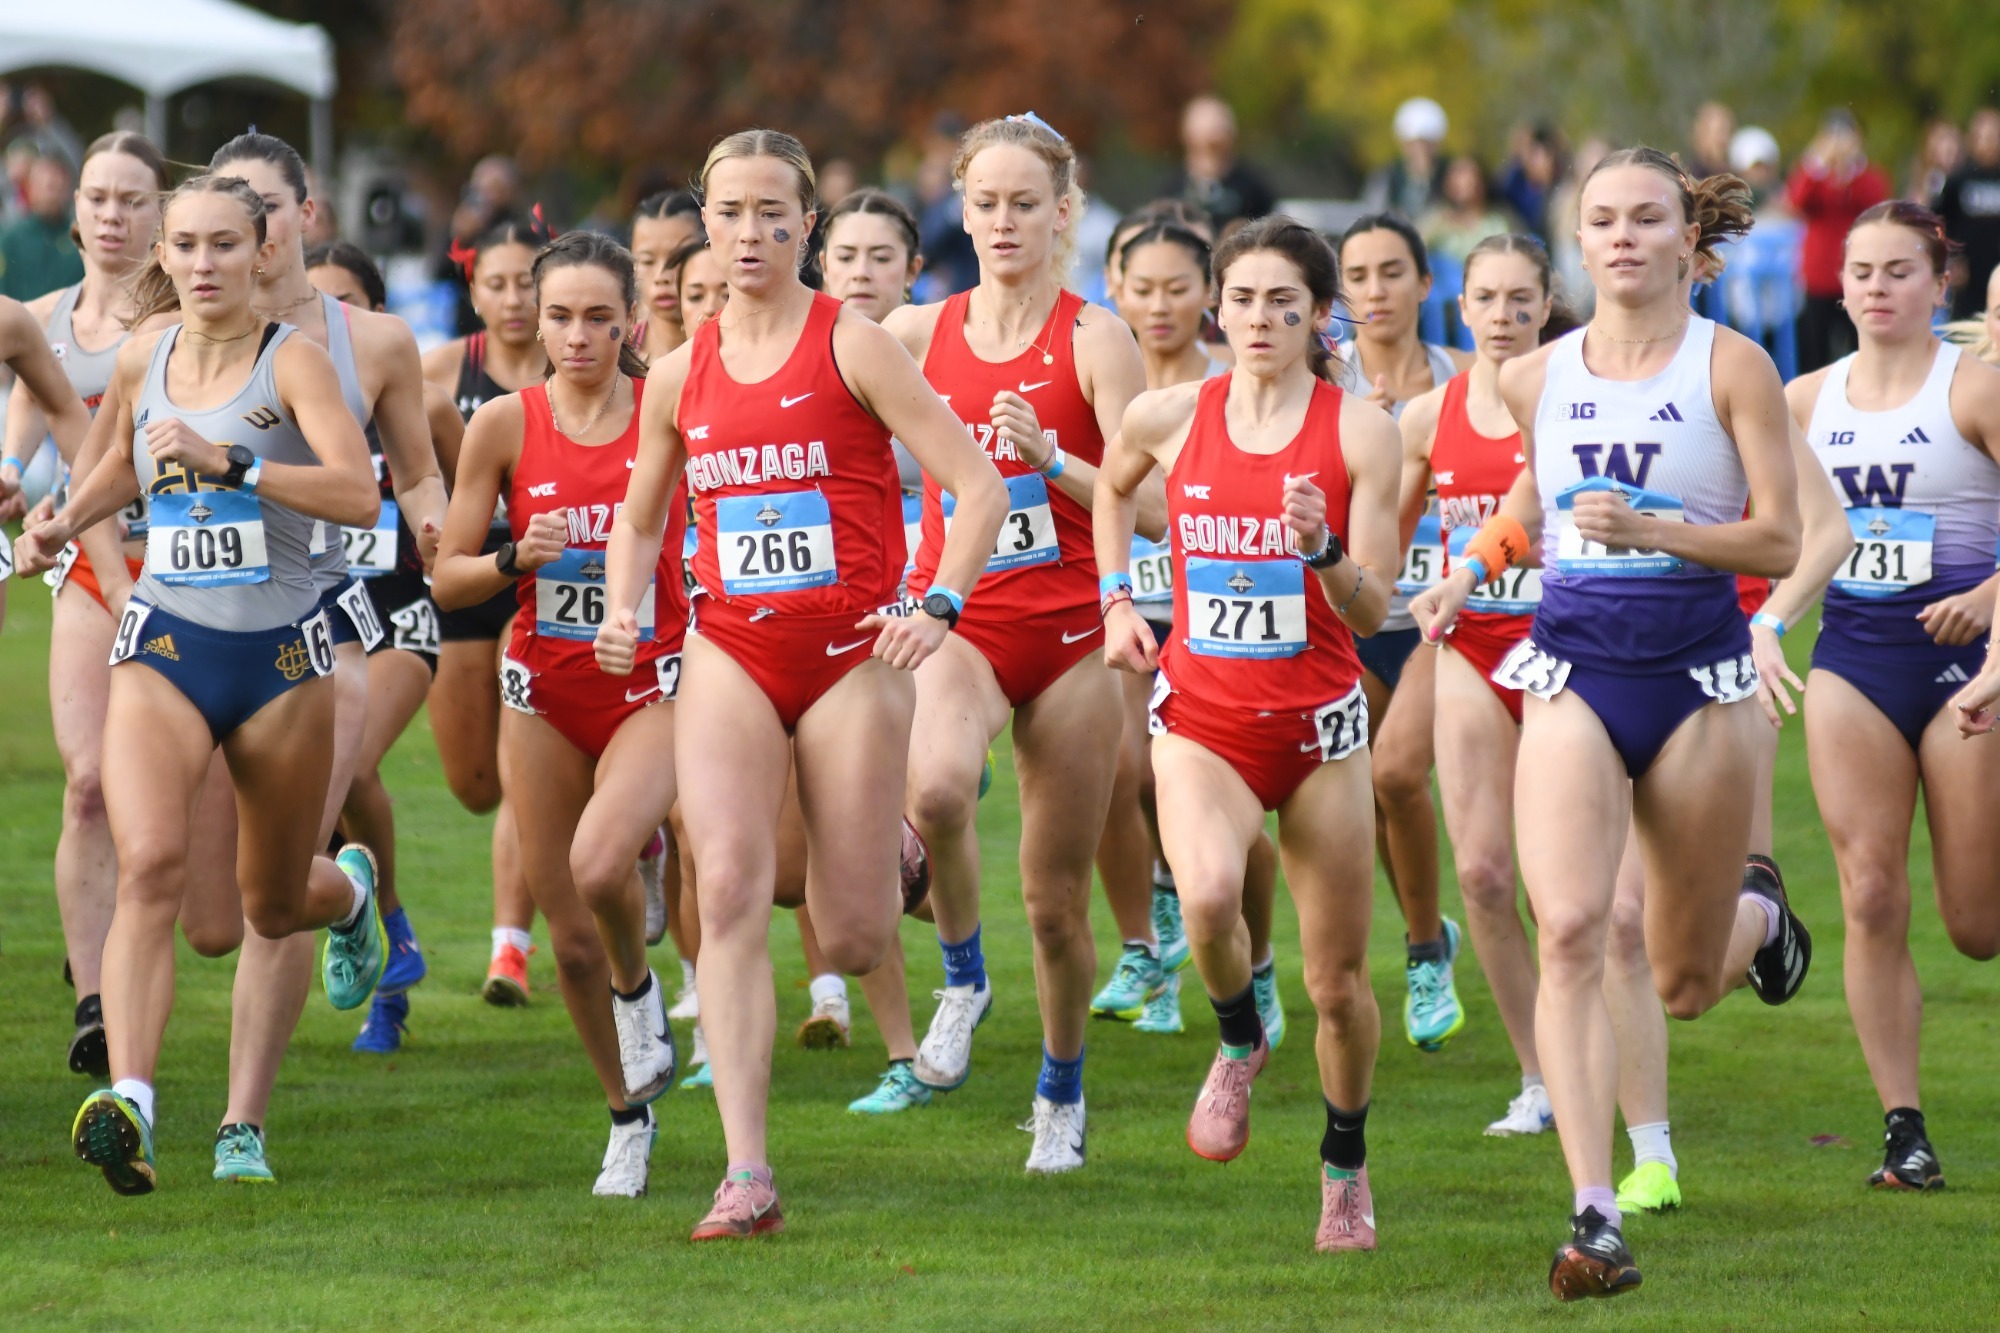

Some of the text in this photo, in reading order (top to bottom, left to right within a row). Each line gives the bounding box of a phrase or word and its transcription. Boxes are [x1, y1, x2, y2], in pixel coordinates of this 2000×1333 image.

[689, 441, 829, 492] GONZAGA
[1572, 443, 1663, 490] W
[1832, 463, 1915, 508] W
[170, 526, 243, 571] 609
[737, 531, 812, 576] 266
[1850, 542, 1908, 581] 731
[114, 610, 138, 661] 9
[1208, 598, 1281, 641] 271
[143, 642, 180, 662] adidas
